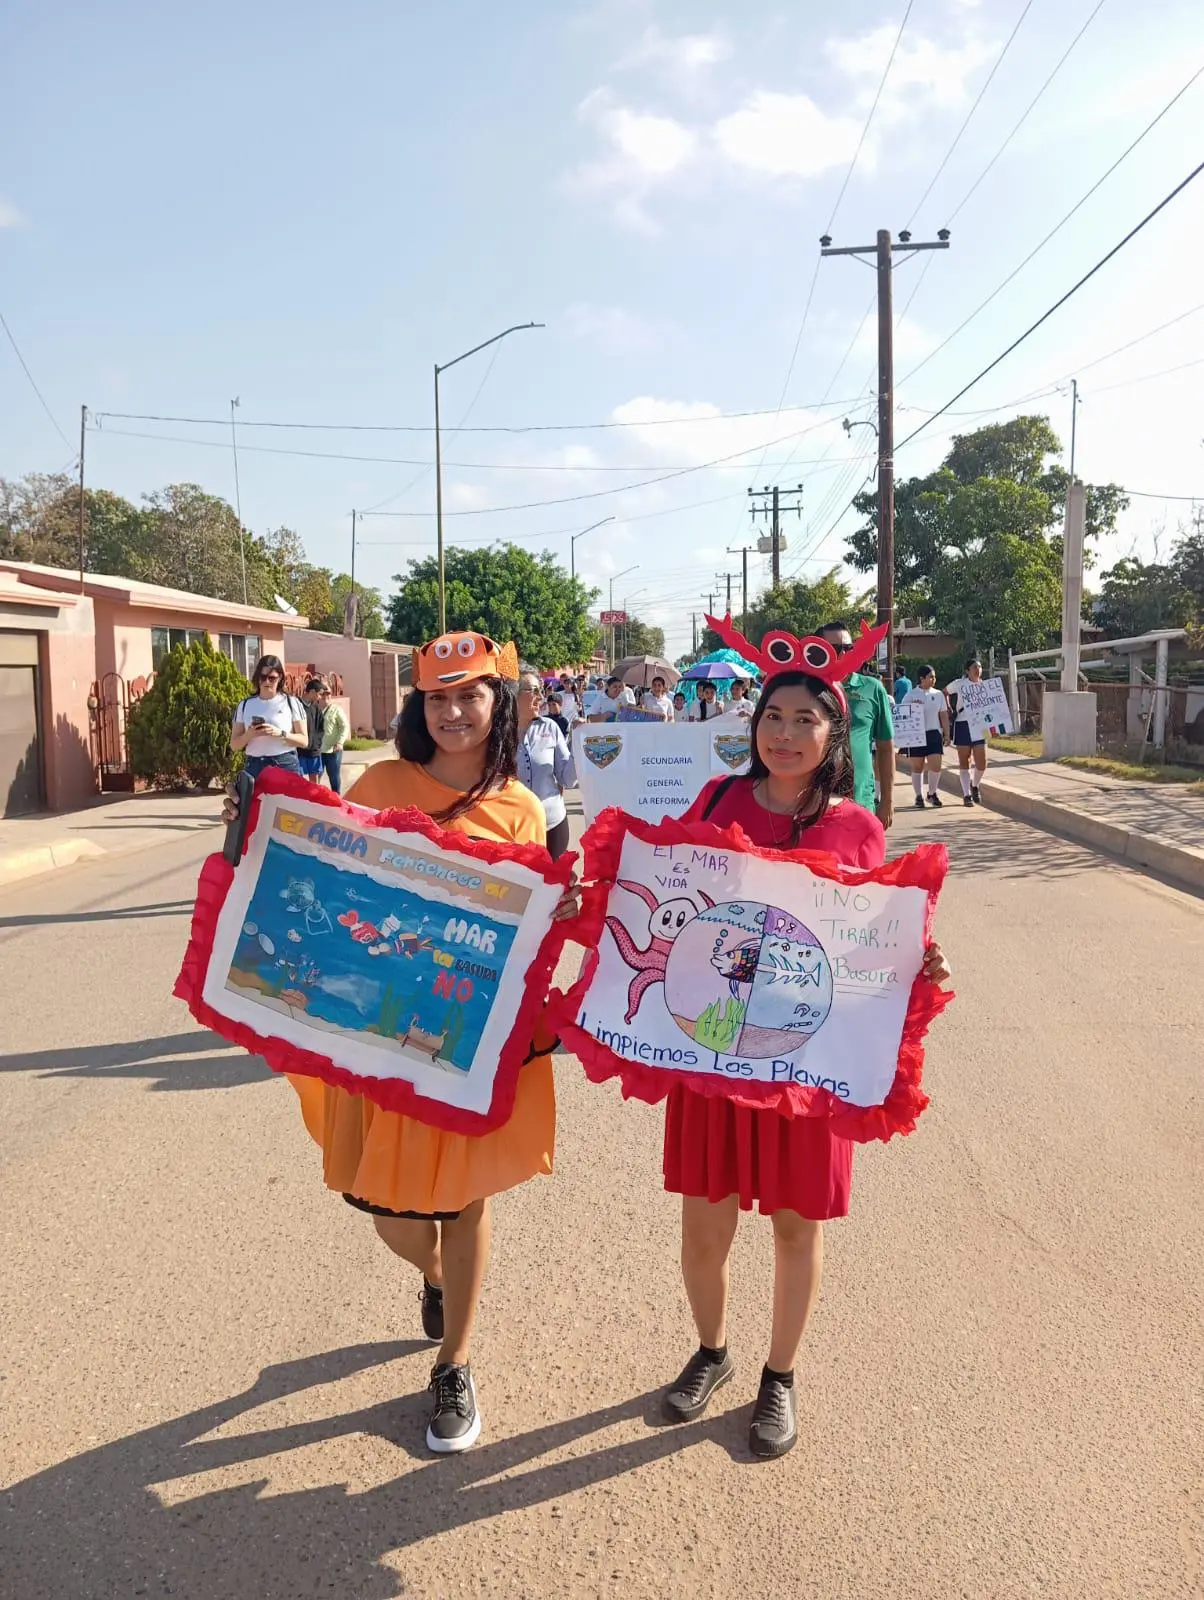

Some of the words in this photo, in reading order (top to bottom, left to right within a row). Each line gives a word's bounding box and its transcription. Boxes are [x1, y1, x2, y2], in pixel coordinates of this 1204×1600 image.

[640, 757, 693, 765] SECUNDARIA
[646, 779, 683, 787] GENERAL
[638, 797, 648, 805] LA
[650, 797, 690, 805] REFORMA
[308, 821, 368, 858] AGUA
[691, 850, 729, 876] MAR
[655, 875, 688, 889] VIDA
[443, 917, 498, 954] MAR
[455, 958, 498, 982] BASURA
[832, 956, 898, 984] Basura
[432, 969, 474, 1003] NO
[713, 1051, 754, 1076] Las
